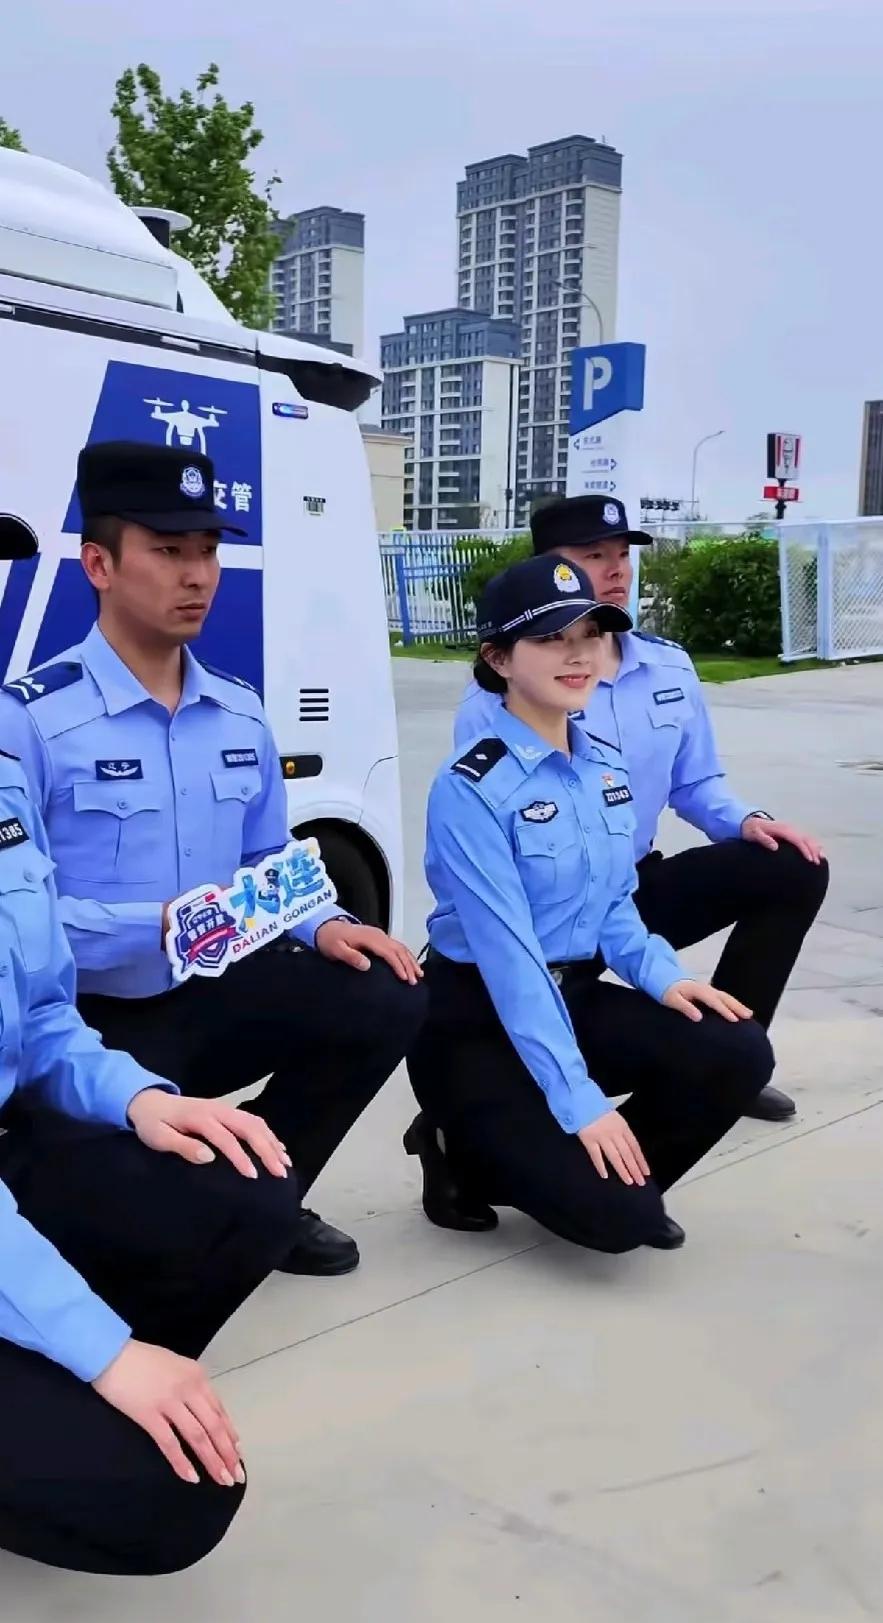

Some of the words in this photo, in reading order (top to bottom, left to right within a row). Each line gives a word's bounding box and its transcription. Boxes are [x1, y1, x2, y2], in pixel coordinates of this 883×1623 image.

[583, 355, 612, 411] P
[229, 847, 325, 933] 大连
[232, 920, 279, 955] DALIAN
[283, 889, 333, 924] GONGAN
